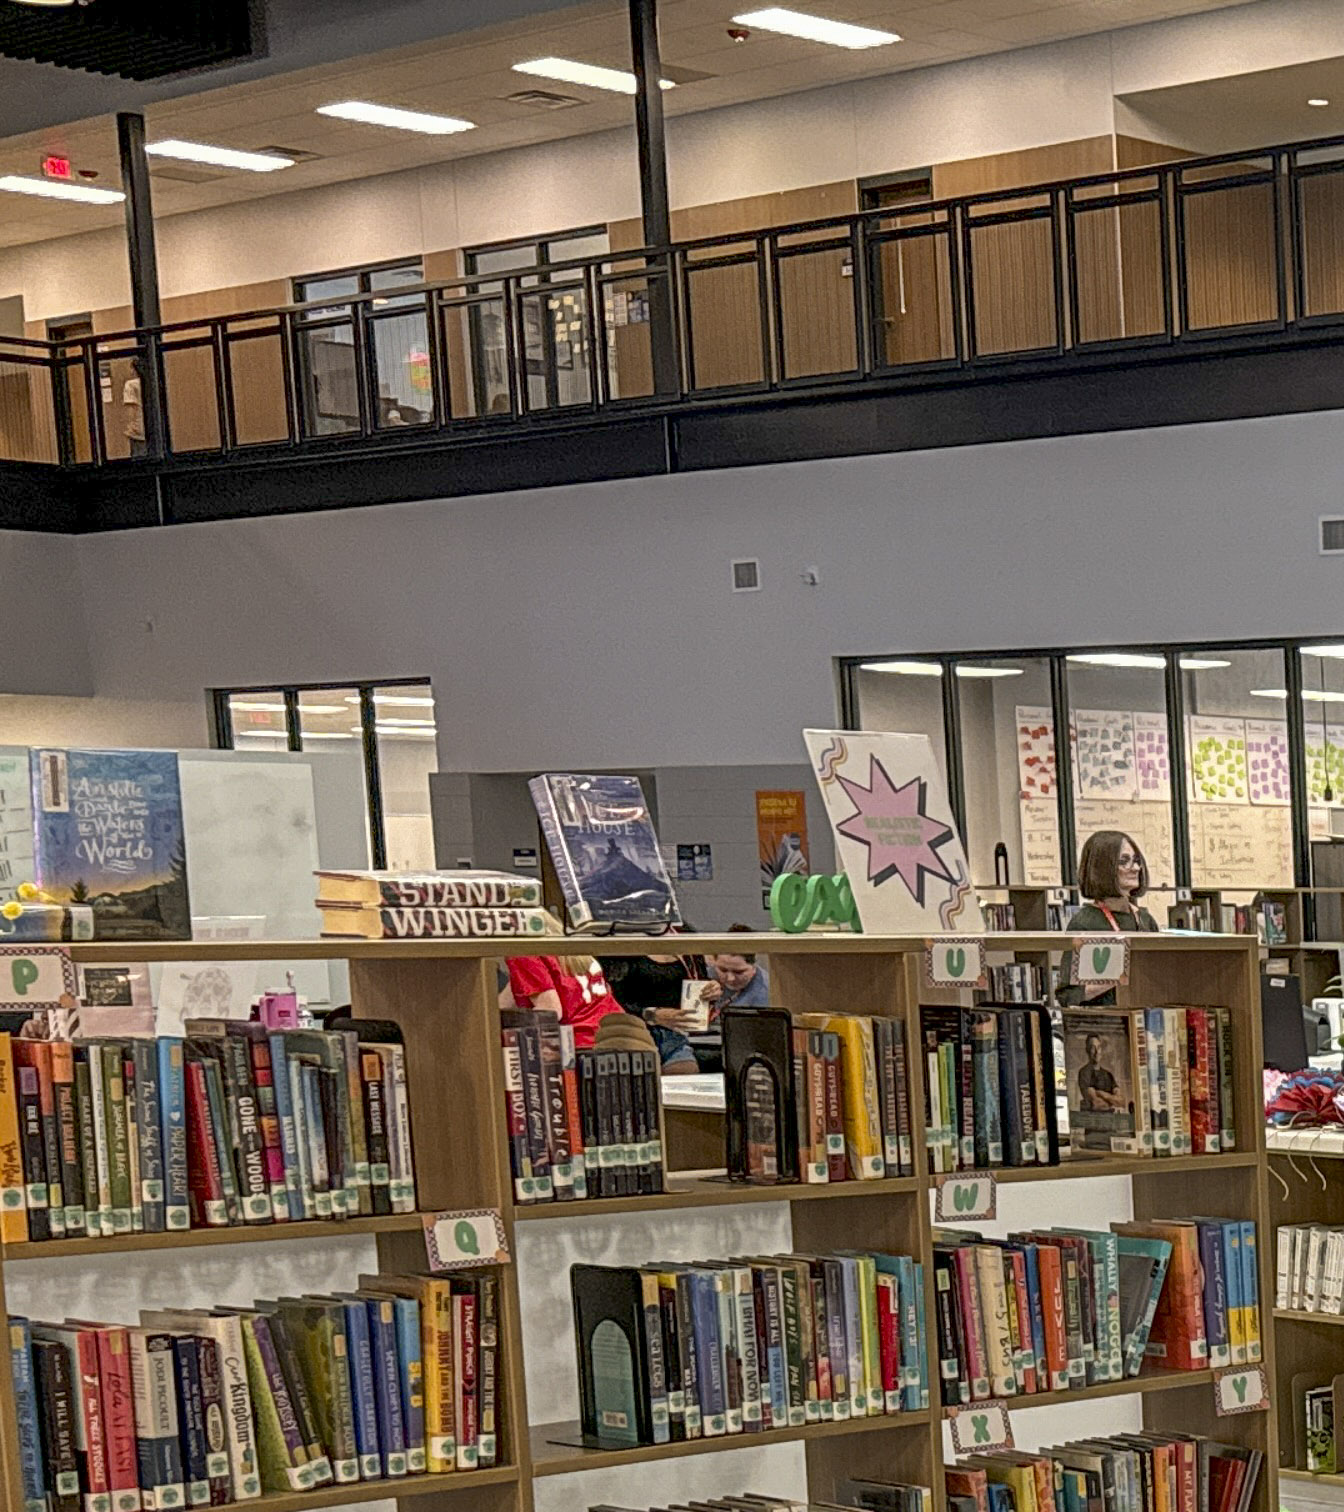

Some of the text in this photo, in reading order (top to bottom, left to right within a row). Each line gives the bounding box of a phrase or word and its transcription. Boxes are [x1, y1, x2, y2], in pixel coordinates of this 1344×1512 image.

[577, 823, 636, 836] HOUSE
[75, 838, 154, 865] World
[11, 958, 39, 995] P
[946, 948, 966, 978] U
[1092, 947, 1111, 975] V
[506, 1050, 527, 1121] FIRST BOY
[238, 1096, 258, 1136] GONE
[548, 1073, 568, 1158] Trouble
[168, 1126, 188, 1198] PAPER HEART
[953, 1183, 979, 1212] W
[454, 1220, 481, 1255] Q
[1107, 1305, 1121, 1361] NOGG
[107, 1372, 130, 1409] Lola
[153, 1357, 170, 1431] JODI PICOULT
[437, 1330, 453, 1433] JOHNNY BOMB
[1232, 1376, 1248, 1403] Y
[89, 1397, 99, 1414] ALL
[229, 1382, 253, 1445] Kingdom
[971, 1414, 992, 1443] X
[1183, 1470, 1193, 1487] MY
